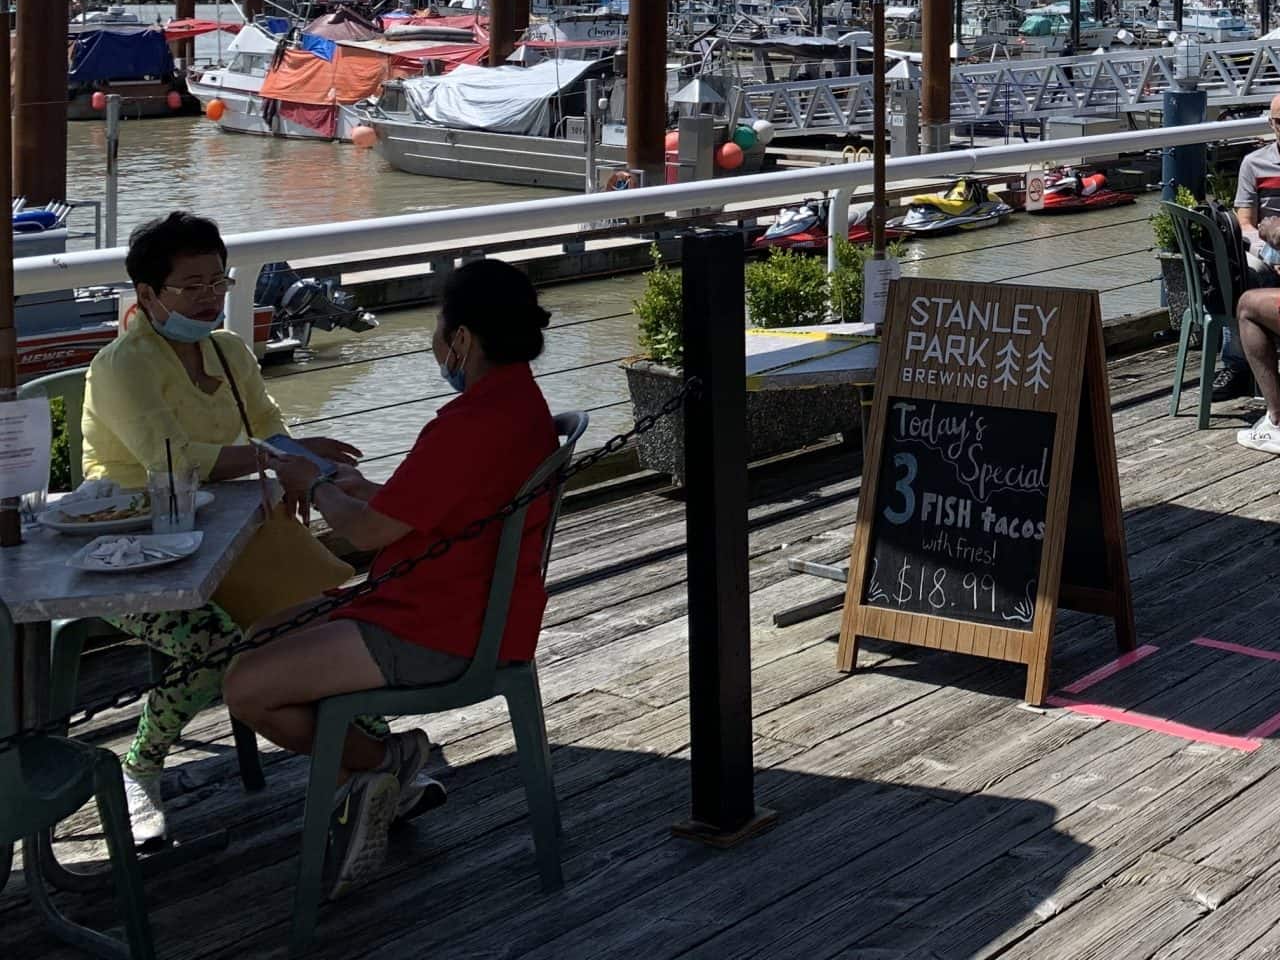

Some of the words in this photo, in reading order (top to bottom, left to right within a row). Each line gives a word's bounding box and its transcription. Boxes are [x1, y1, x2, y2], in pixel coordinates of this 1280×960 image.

[910, 296, 1058, 337] STANLEY
[904, 330, 991, 368] PARK
[902, 367, 988, 389] BREWING
[893, 402, 989, 460] Today's
[882, 452, 919, 525] 3
[920, 492, 973, 529] FISH
[981, 506, 1047, 540] tacos
[961, 443, 1049, 500] Special
[922, 530, 953, 558] with
[892, 556, 996, 613] $18.99
